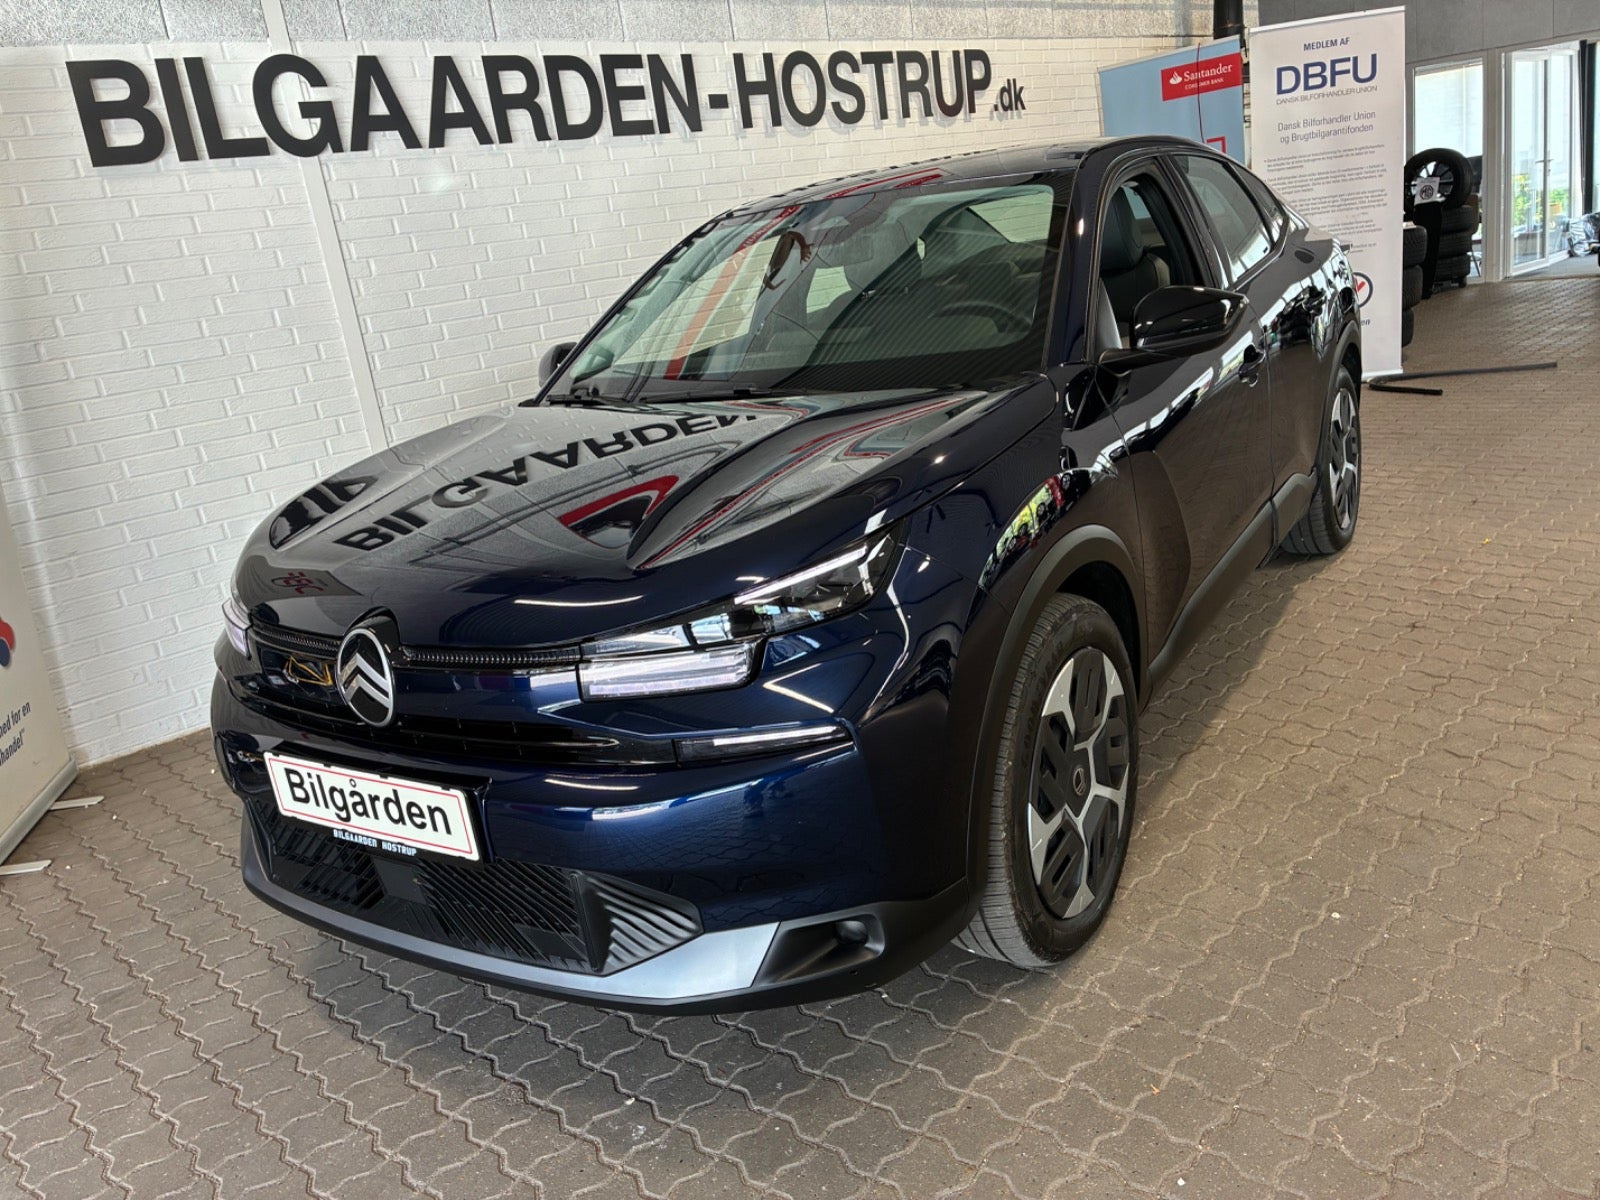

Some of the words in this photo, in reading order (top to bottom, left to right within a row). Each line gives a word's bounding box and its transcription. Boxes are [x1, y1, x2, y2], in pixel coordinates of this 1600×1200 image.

[1303, 38, 1338, 51] MEDLEM
[1339, 37, 1350, 46] AF
[1183, 63, 1233, 82] Santander
[1276, 53, 1377, 95] DBFU
[1185, 80, 1210, 90] CONSMER
[1276, 95, 1299, 105] DANSK
[1300, 88, 1356, 102] BILFORHANDLER
[1355, 85, 1378, 95] UNION
[1277, 119, 1302, 132] Dansk
[1302, 113, 1352, 130] Bilforhandler
[1353, 110, 1376, 121] Union
[1280, 136, 1290, 145] og
[1291, 123, 1374, 143] Brugtbilgarantifonden
[11, 709, 21, 726] for
[22, 702, 31, 717] en
[284, 767, 452, 835] Bilgården
[333, 828, 378, 848] BILGAARDEN
[381, 841, 417, 857] HOSTRUP
